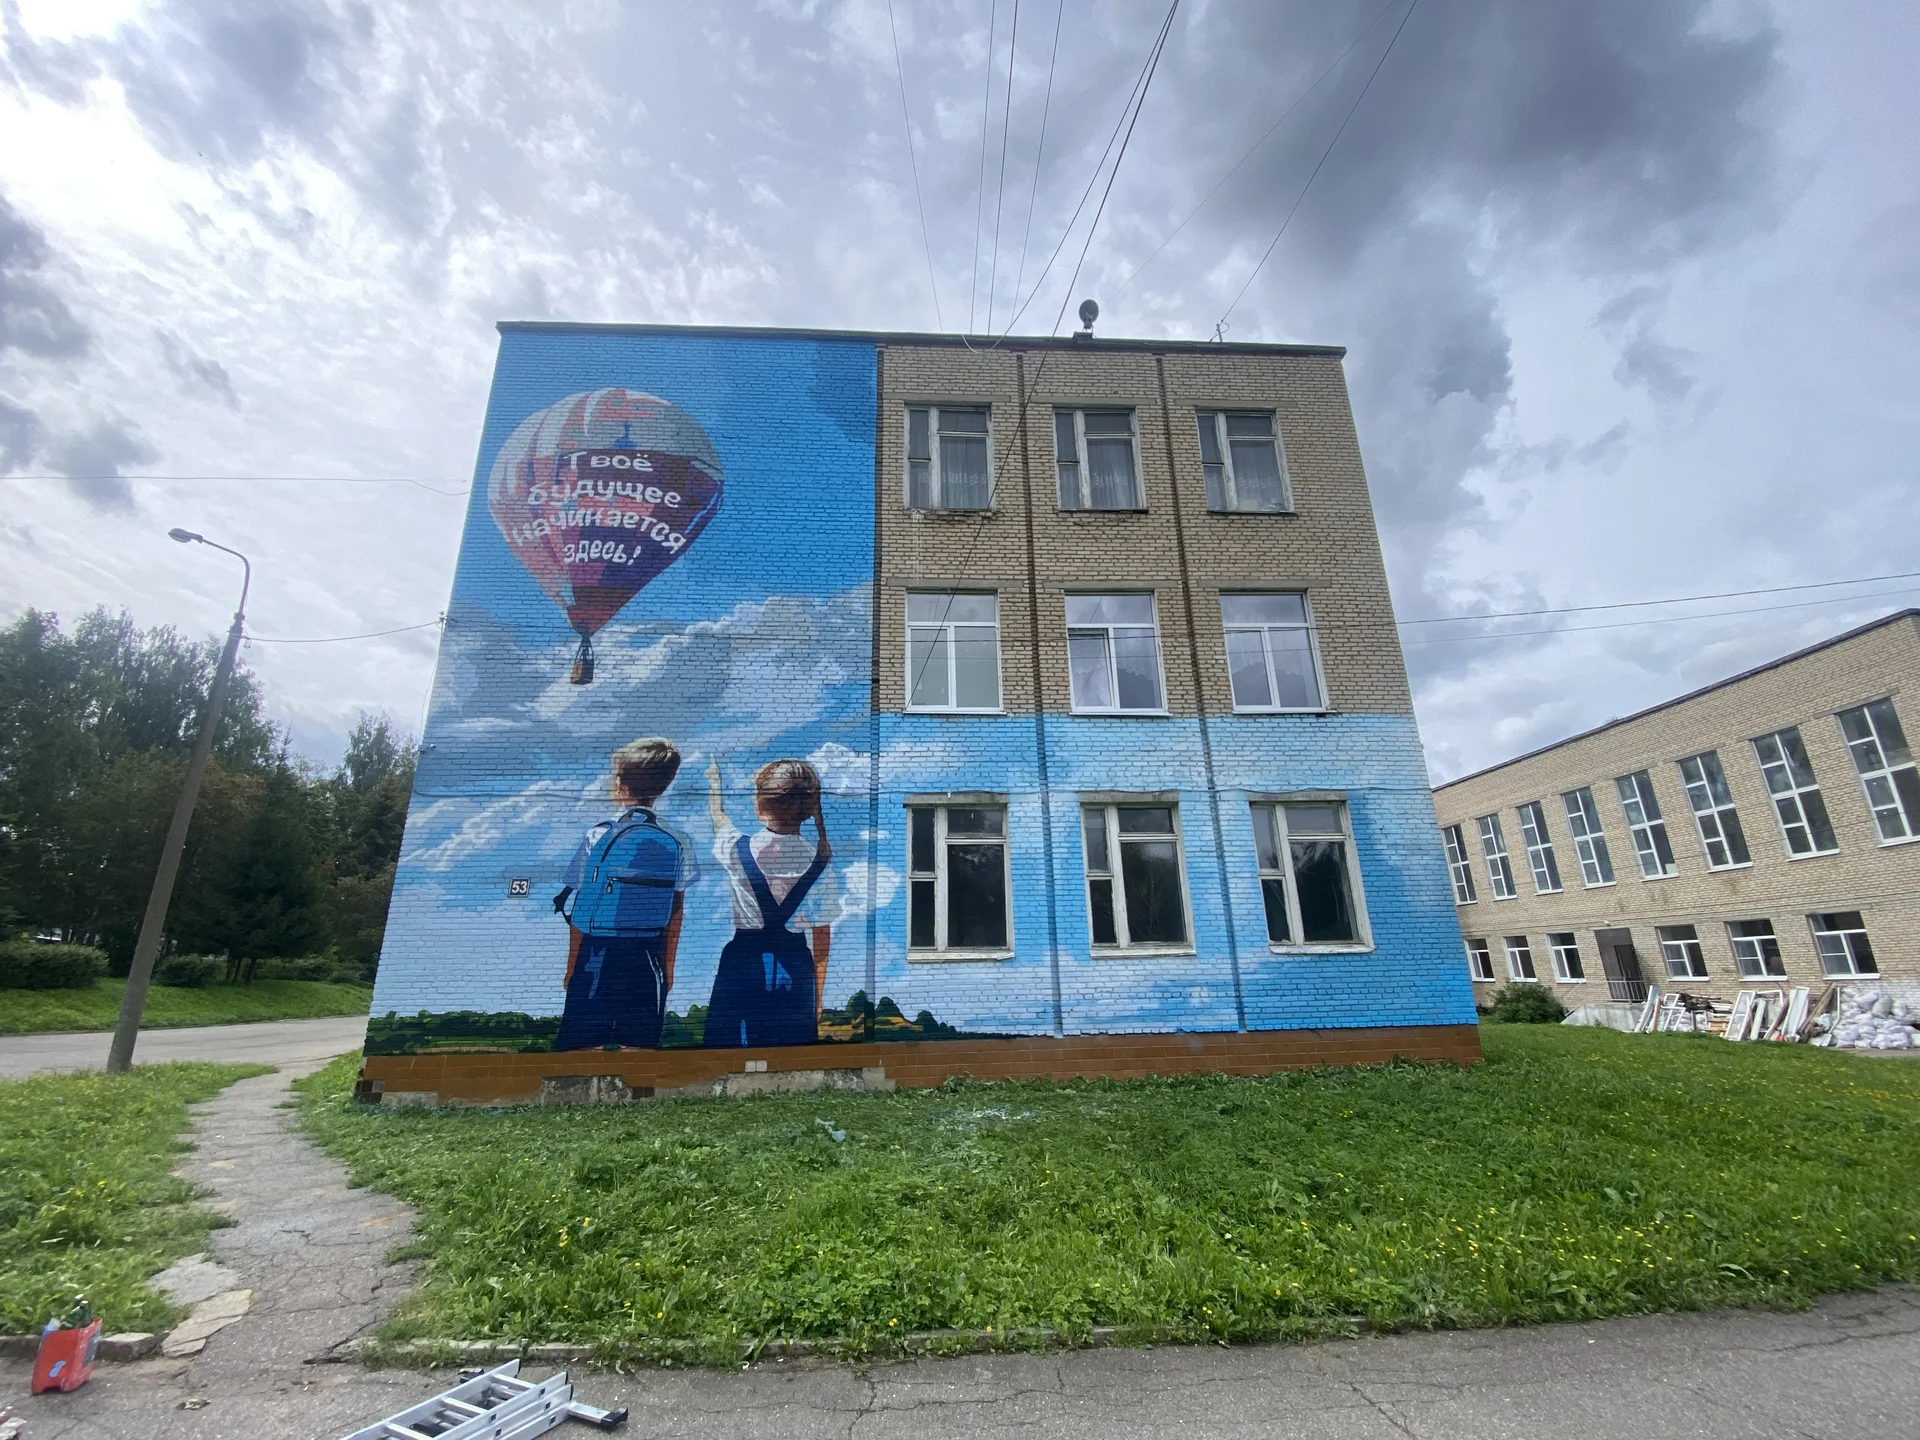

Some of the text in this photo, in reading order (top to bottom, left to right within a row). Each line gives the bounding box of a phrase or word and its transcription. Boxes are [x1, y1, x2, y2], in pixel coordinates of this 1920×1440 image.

[563, 451, 654, 472] Твоё
[527, 479, 682, 508] будущее
[512, 507, 687, 554] начинается
[563, 540, 642, 565] здесь!
[511, 881, 528, 894] 53
